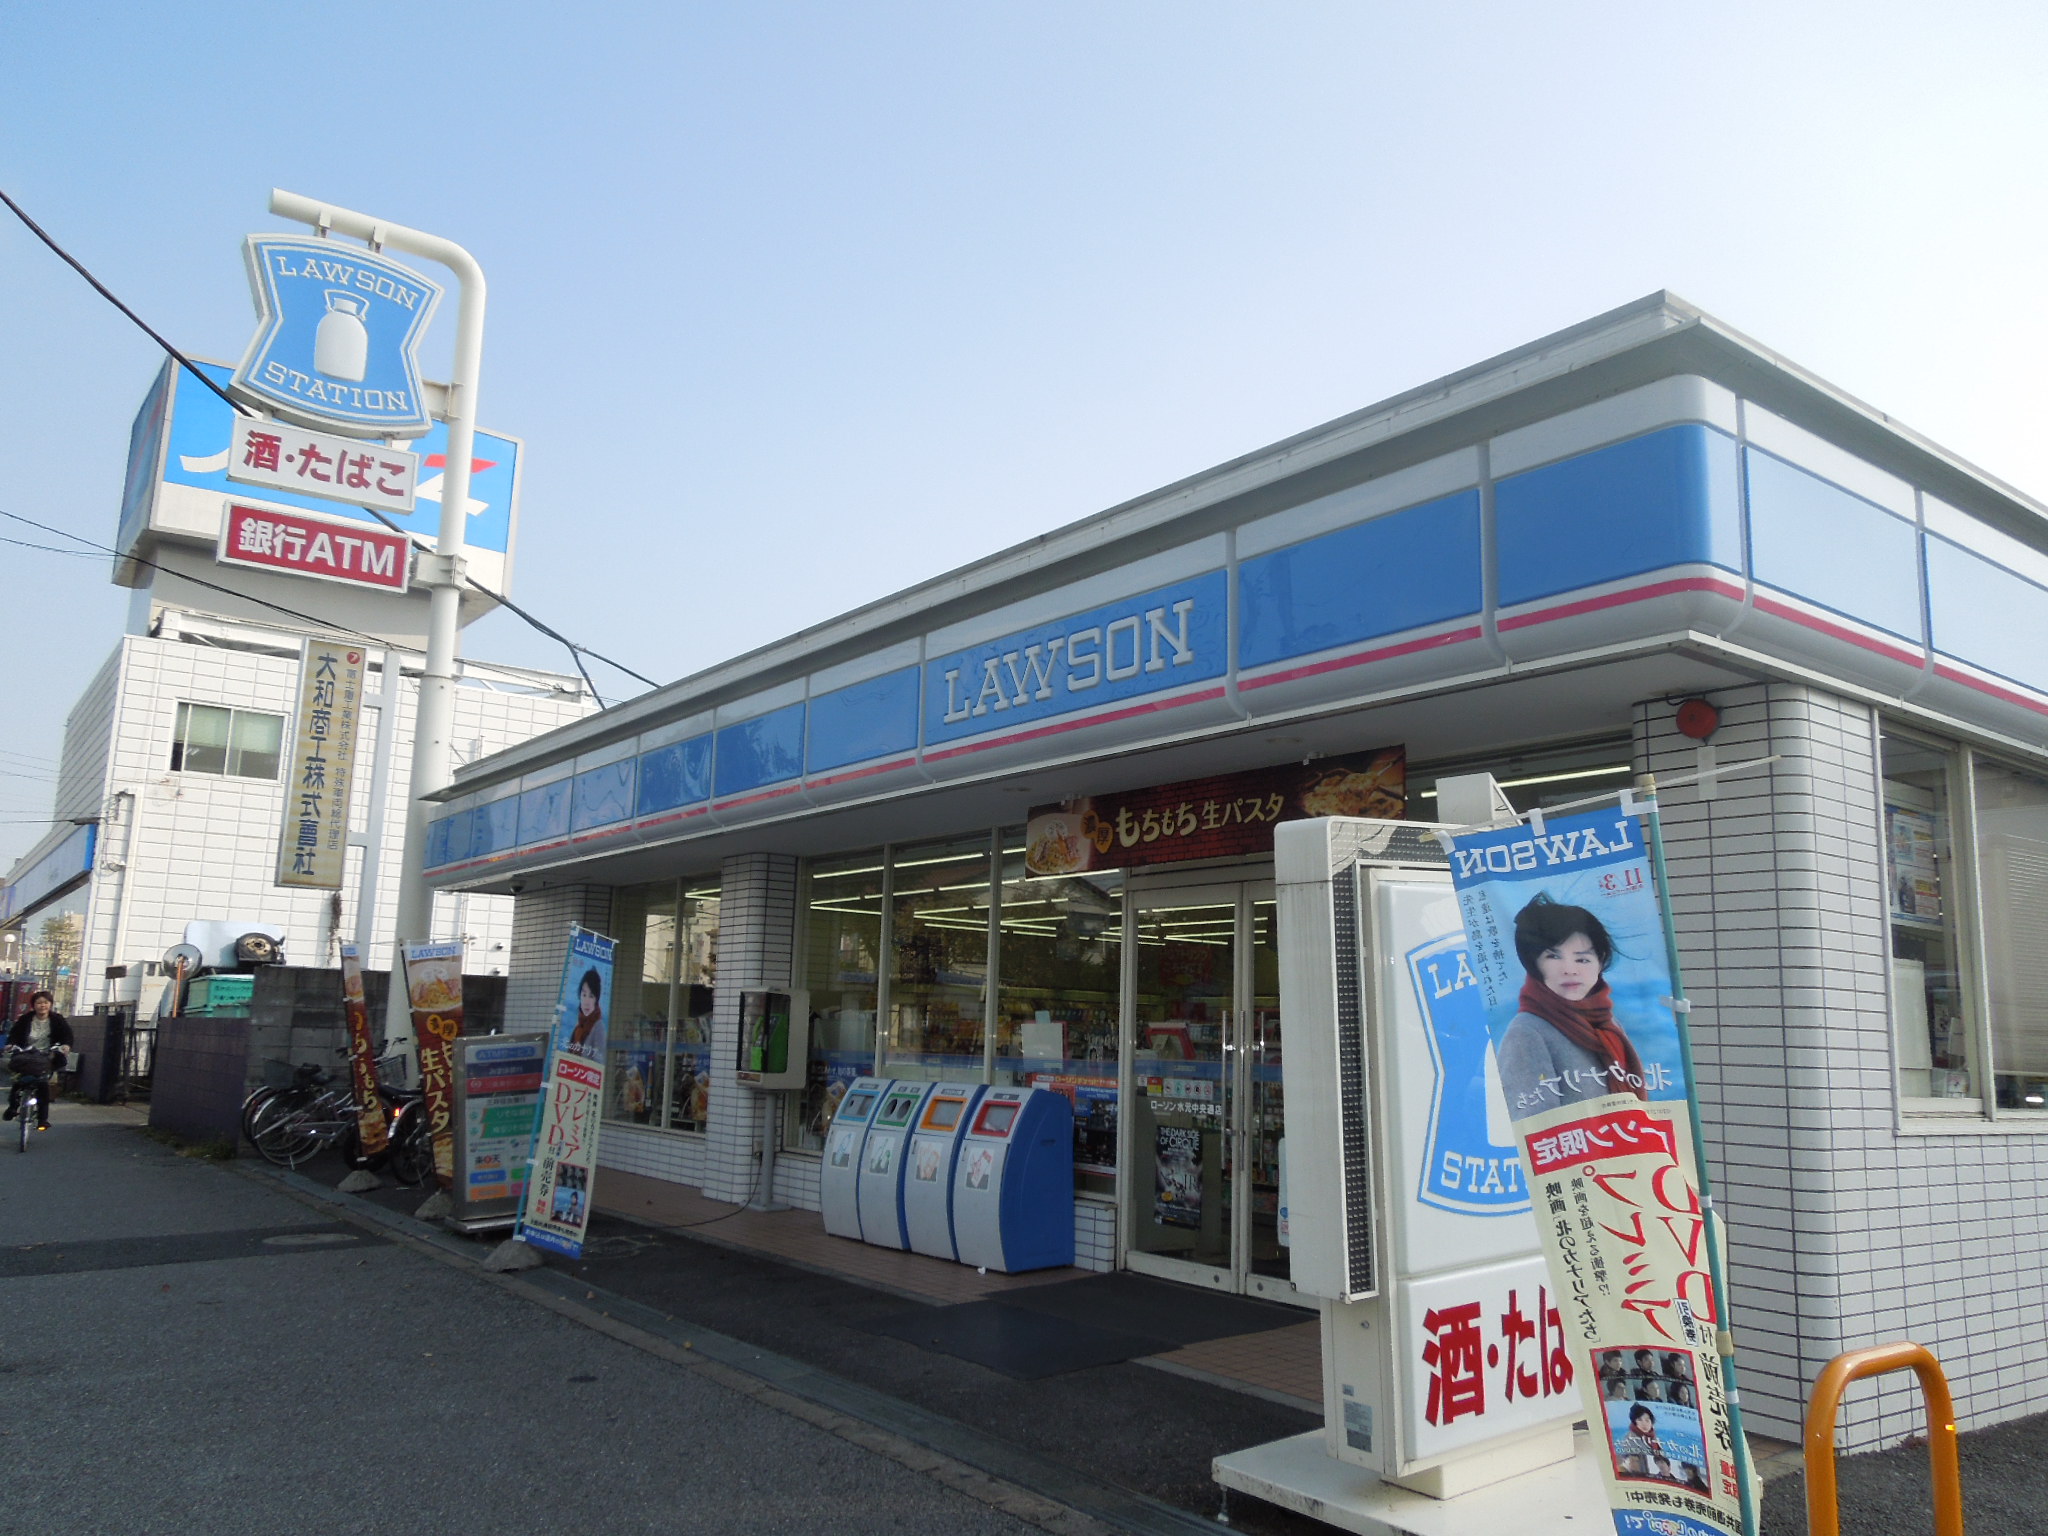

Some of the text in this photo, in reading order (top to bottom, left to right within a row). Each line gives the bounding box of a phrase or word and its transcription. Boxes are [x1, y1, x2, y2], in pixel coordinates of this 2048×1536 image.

[276, 255, 421, 311] LAWSON
[263, 360, 410, 412] STATION
[242, 429, 406, 498] 酒・たばこ
[238, 517, 396, 578] 銀行ATM
[943, 598, 1195, 724] LAWSON
[420, 1047, 451, 1135] 生パスタ
